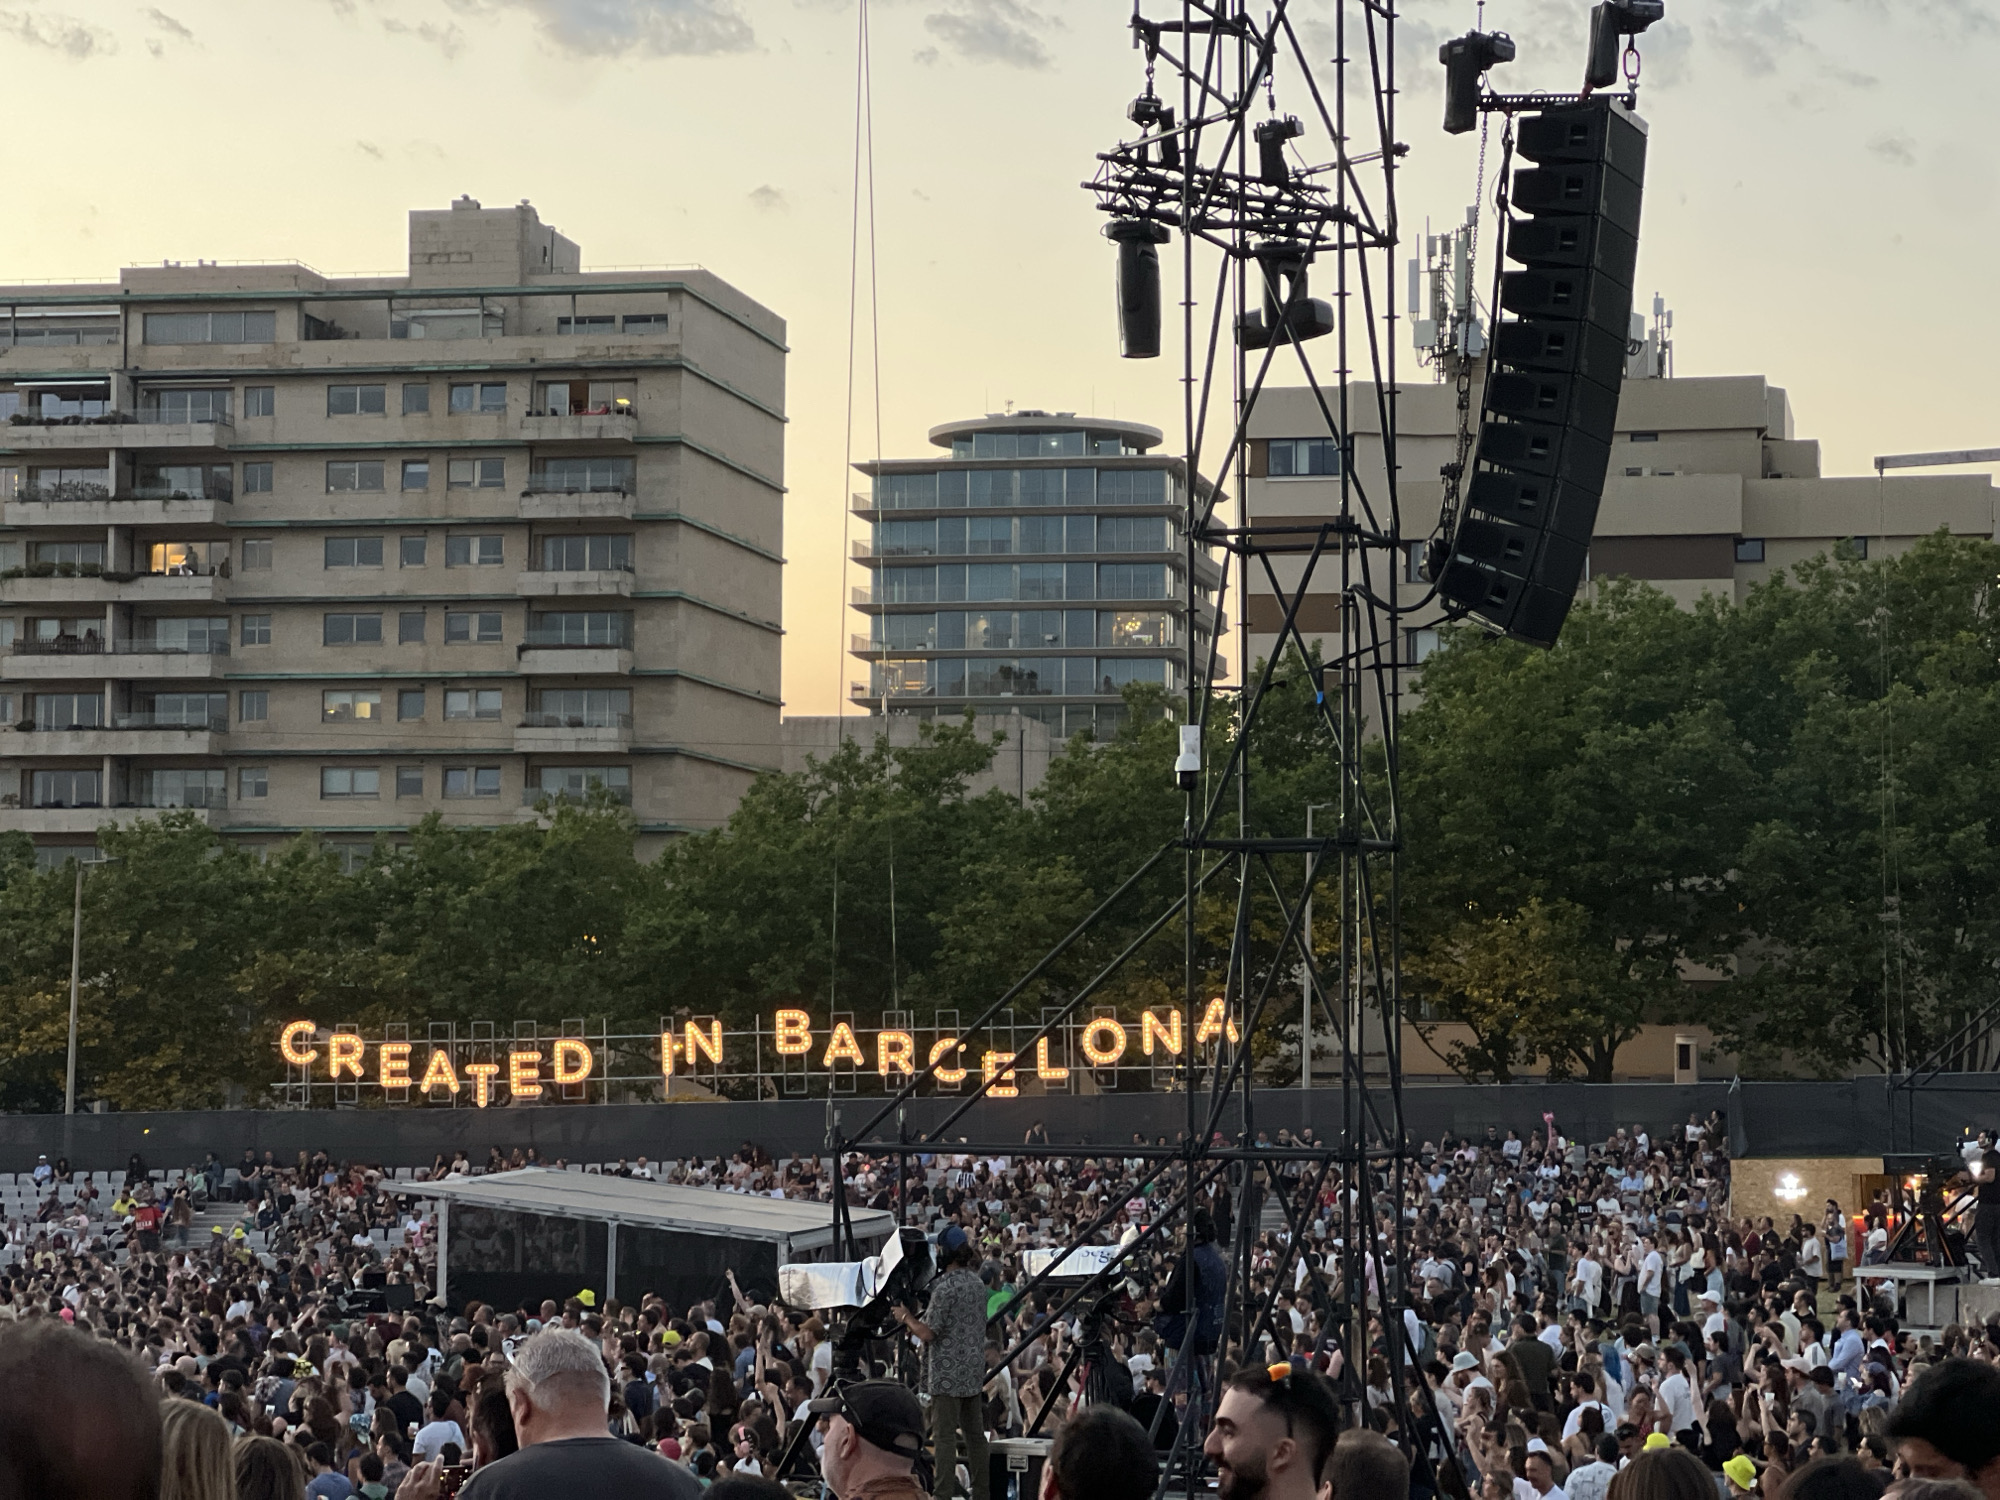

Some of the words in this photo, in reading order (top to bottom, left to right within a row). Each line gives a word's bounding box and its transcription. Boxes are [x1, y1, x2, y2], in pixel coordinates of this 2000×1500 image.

[280, 1020, 593, 1108] CREATED
[661, 1019, 723, 1076] IN
[775, 997, 1239, 1097] BARCELONA
